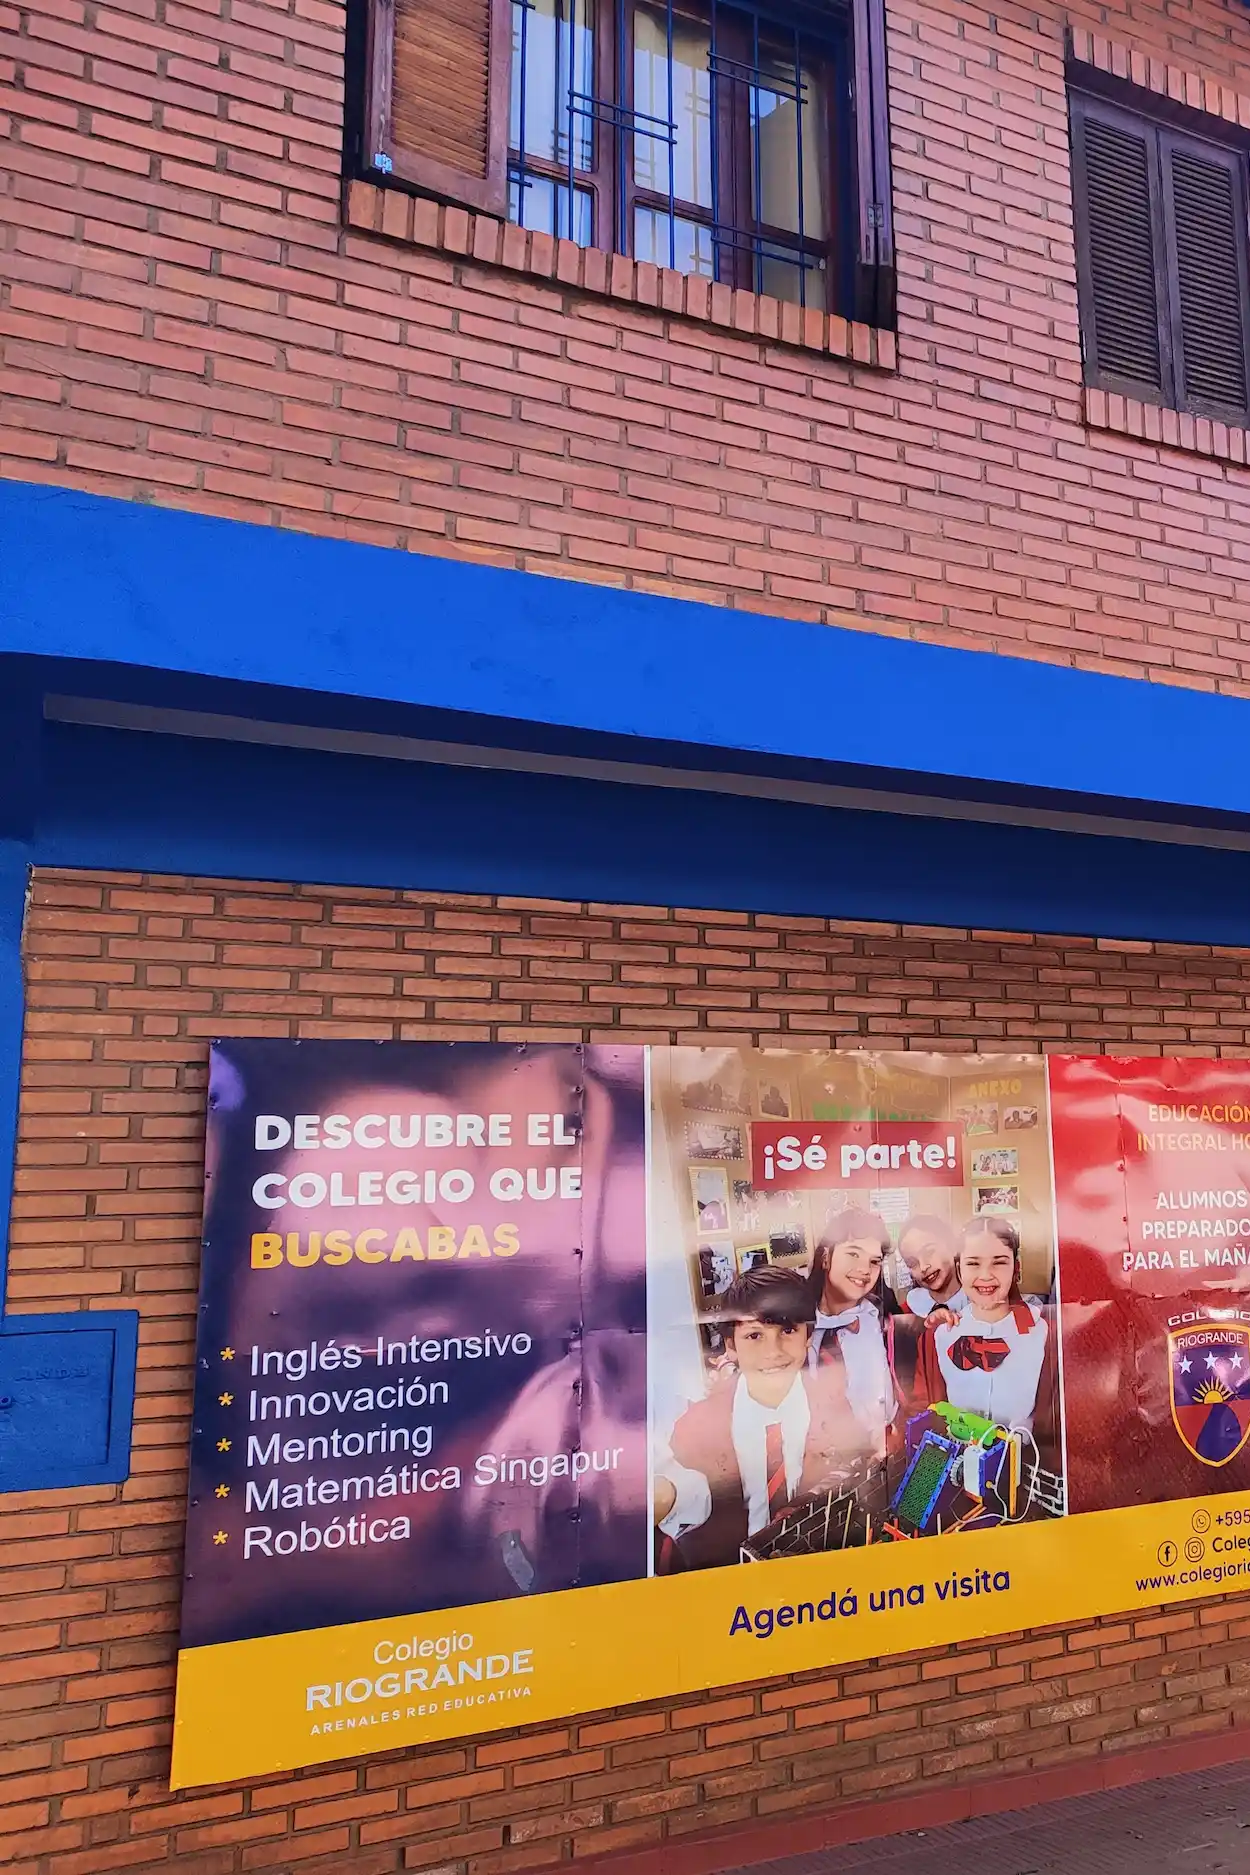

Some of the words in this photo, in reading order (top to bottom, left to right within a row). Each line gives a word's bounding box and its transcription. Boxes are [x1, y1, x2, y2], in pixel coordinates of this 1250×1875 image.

[253, 1113, 513, 1151] DESCUBRE
[526, 1112, 576, 1147] EL
[1136, 1133, 1227, 1152] INTEGRAL
[762, 1134, 828, 1180] ¡Sé
[840, 1135, 957, 1178] parte!
[251, 1168, 475, 1210] COLEGIO
[488, 1165, 583, 1202] QUE
[1155, 1189, 1248, 1210] ALUMNOS
[249, 1223, 520, 1270] BUSCABAS
[1122, 1250, 1174, 1272] PARA
[1179, 1249, 1200, 1269] EL
[249, 1338, 363, 1382] Inglés
[376, 1328, 533, 1366] Intensivo
[1177, 1331, 1245, 1349] RIOGRANDE
[248, 1376, 449, 1422] Innovación
[246, 1424, 434, 1468] Mentoring
[243, 1462, 461, 1514] Matemática
[473, 1444, 624, 1489] Singapur
[243, 1511, 411, 1560] Robótica
[728, 1587, 859, 1639] Agendá
[868, 1582, 925, 1611] una
[934, 1568, 1011, 1602] visita
[373, 1630, 473, 1667] Colegio
[304, 1648, 535, 1712] RIOGRANDE
[309, 1709, 401, 1737] ARENALES
[406, 1702, 438, 1719] RED
[443, 1686, 532, 1713] EDUCATIVA
